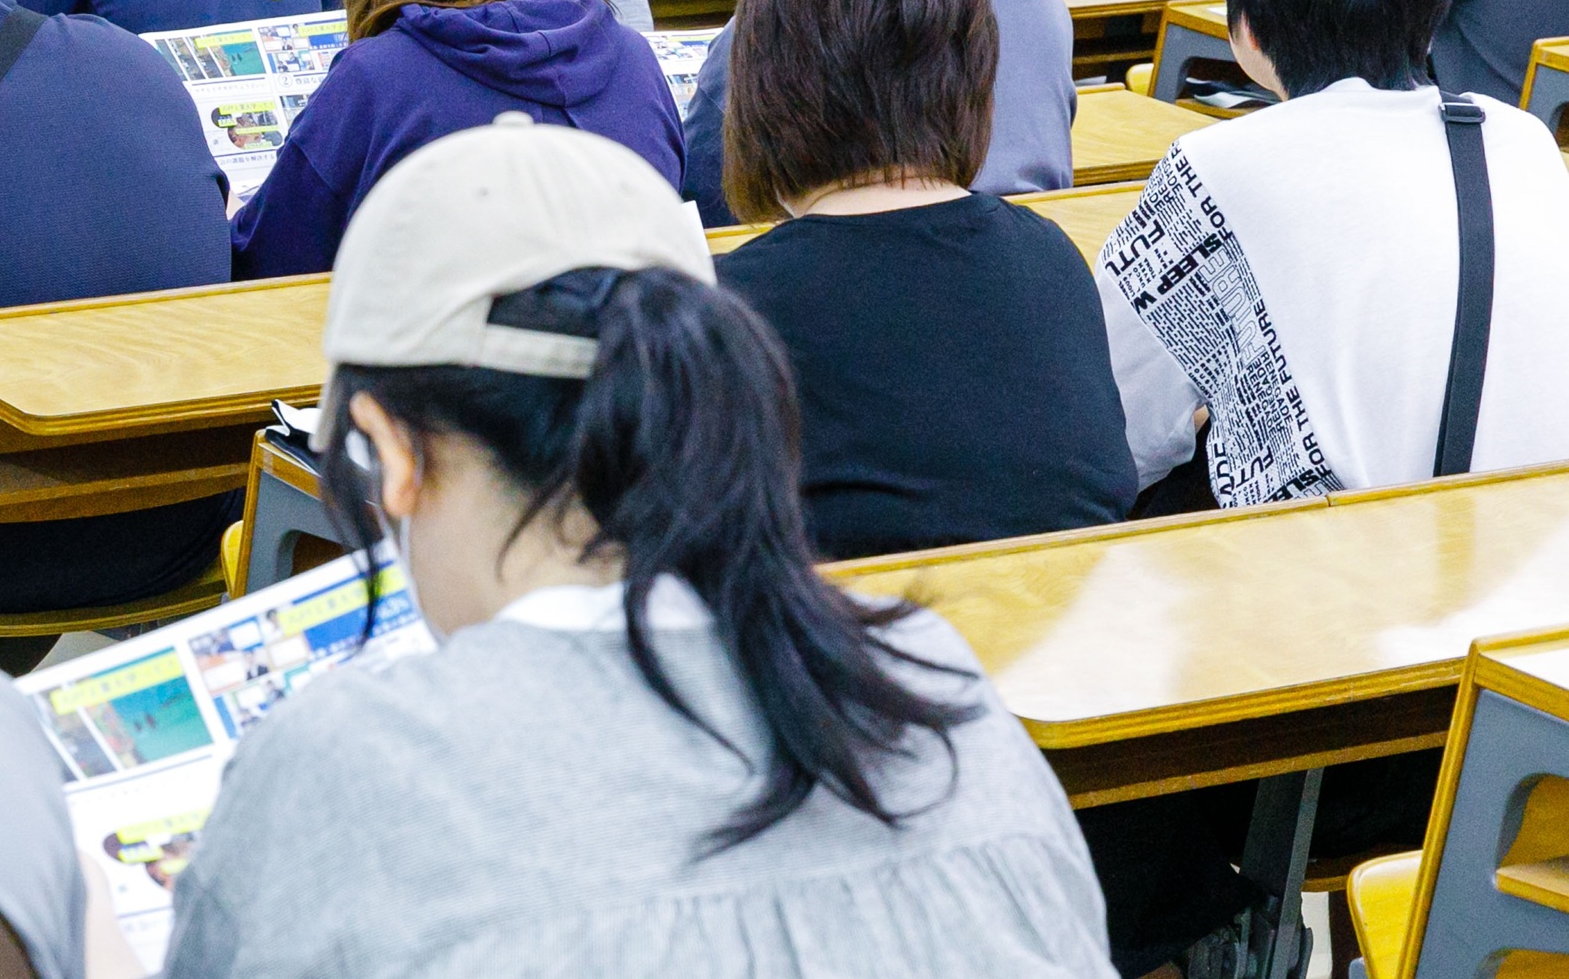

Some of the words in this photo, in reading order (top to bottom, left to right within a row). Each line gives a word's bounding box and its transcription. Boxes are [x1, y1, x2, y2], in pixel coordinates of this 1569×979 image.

[1175, 155, 1203, 198] THE
[1200, 195, 1233, 244] FOR
[1157, 233, 1223, 295] SLEEP
[1197, 246, 1266, 370] FUTURE
[1254, 298, 1292, 386] FUTURE
[1285, 386, 1309, 431] THE
[1302, 432, 1332, 478] FOR
